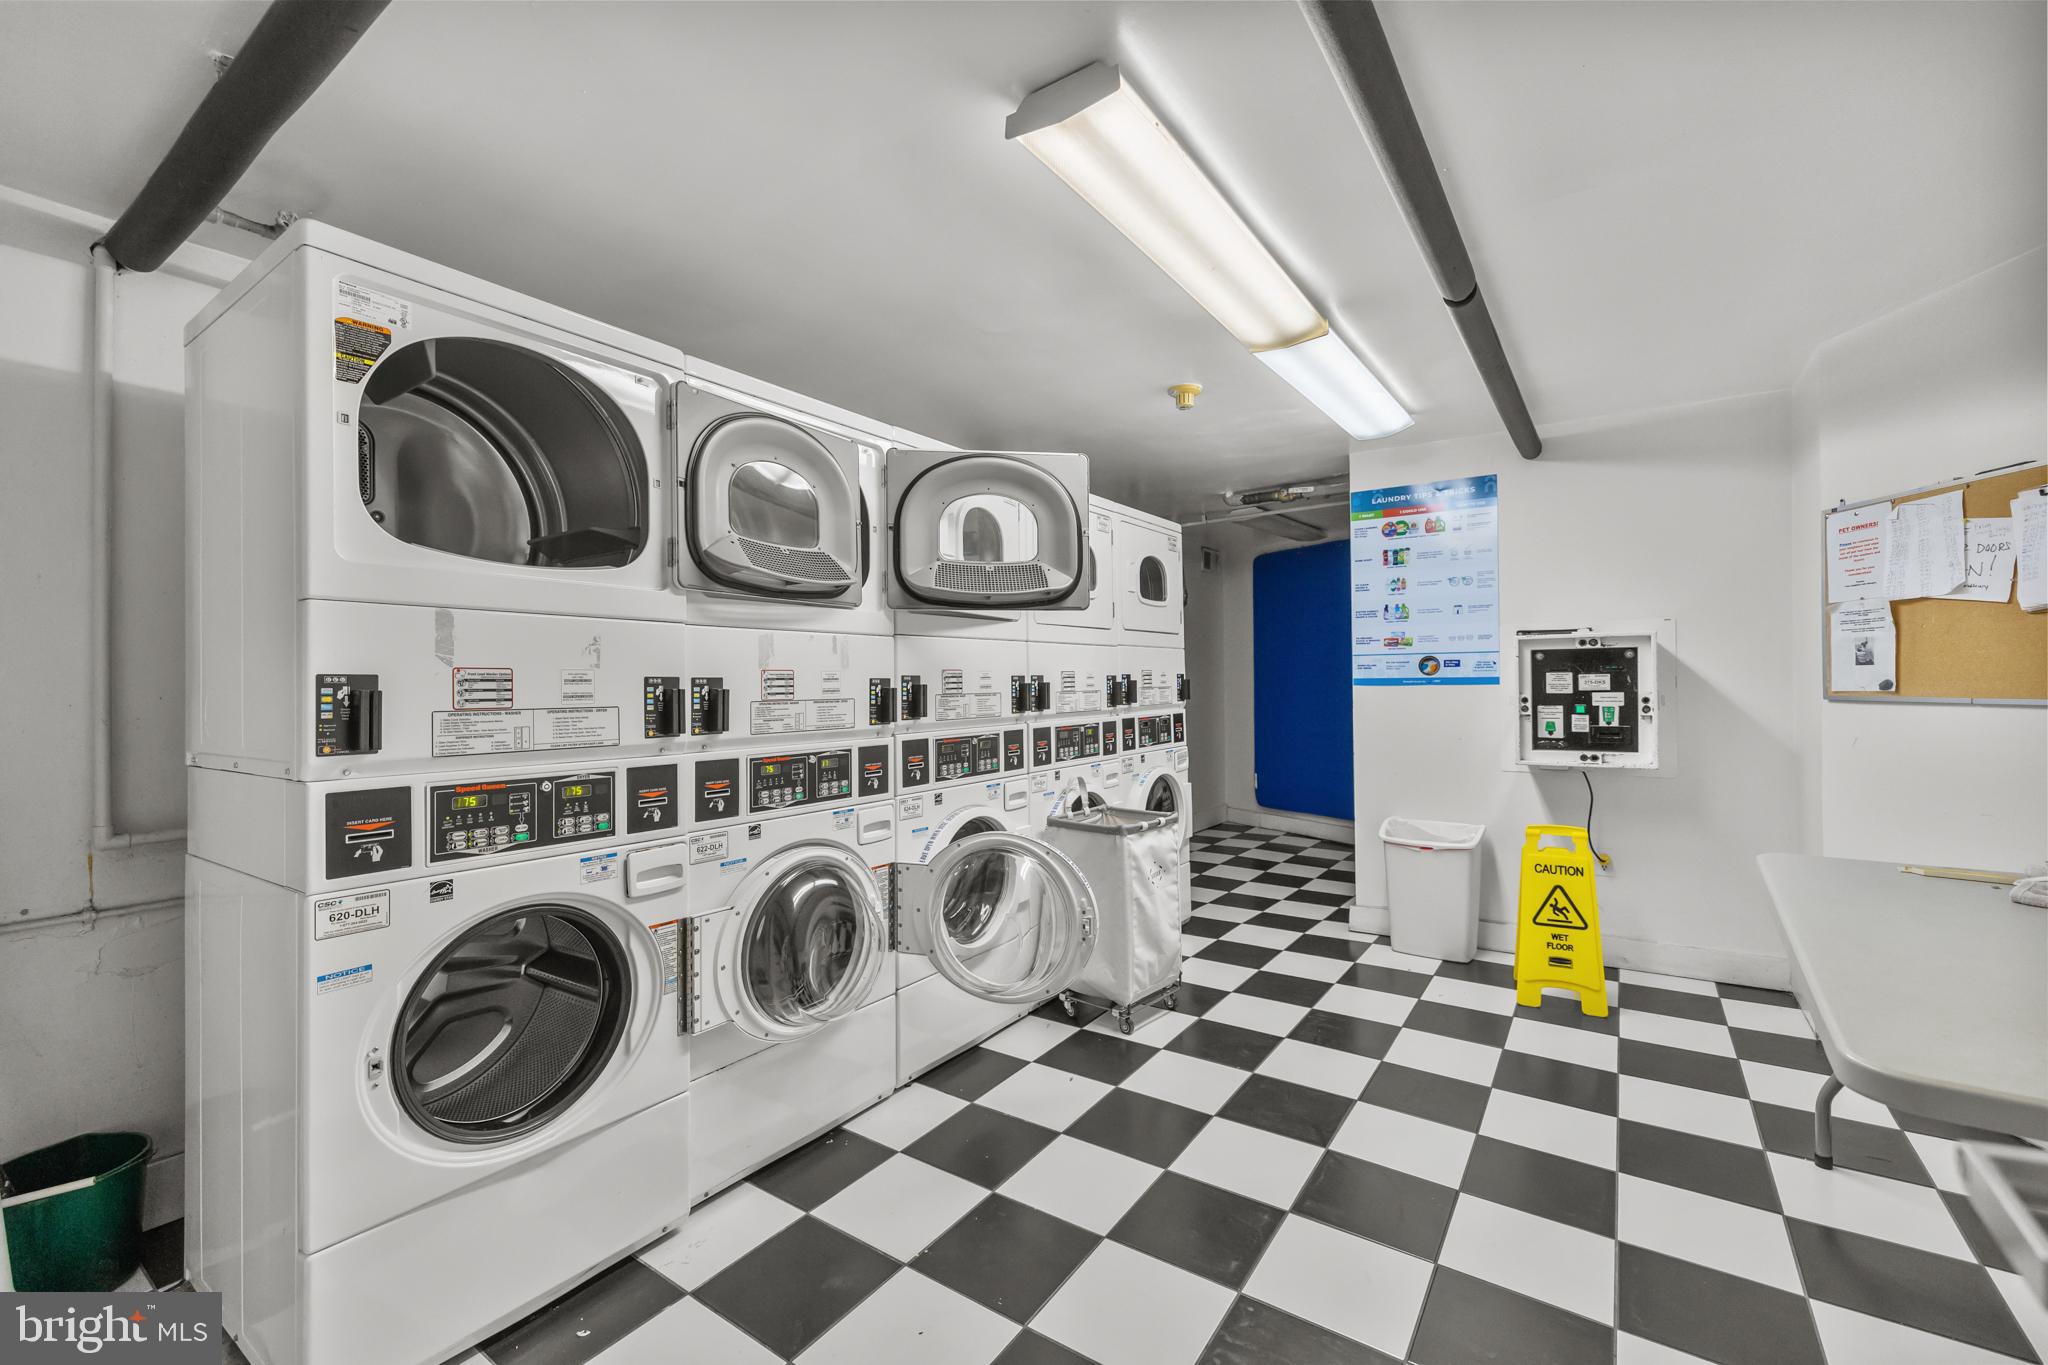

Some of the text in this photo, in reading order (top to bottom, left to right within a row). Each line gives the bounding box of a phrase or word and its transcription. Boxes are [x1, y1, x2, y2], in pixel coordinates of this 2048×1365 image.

[1371, 494, 1411, 505] LAUNDRY
[1414, 492, 1433, 500] TIPS
[1851, 521, 1879, 530] OWNERS!
[1976, 541, 2012, 554] DOORS
[455, 785, 481, 793] Speed
[464, 796, 476, 807] 75
[1534, 863, 1584, 877] CAUTION
[317, 900, 337, 908] CSC
[329, 905, 380, 923] 620-DLH
[1551, 933, 1568, 942] WET
[1546, 941, 1574, 952] FLOOR
[325, 966, 365, 980] NOTICE
